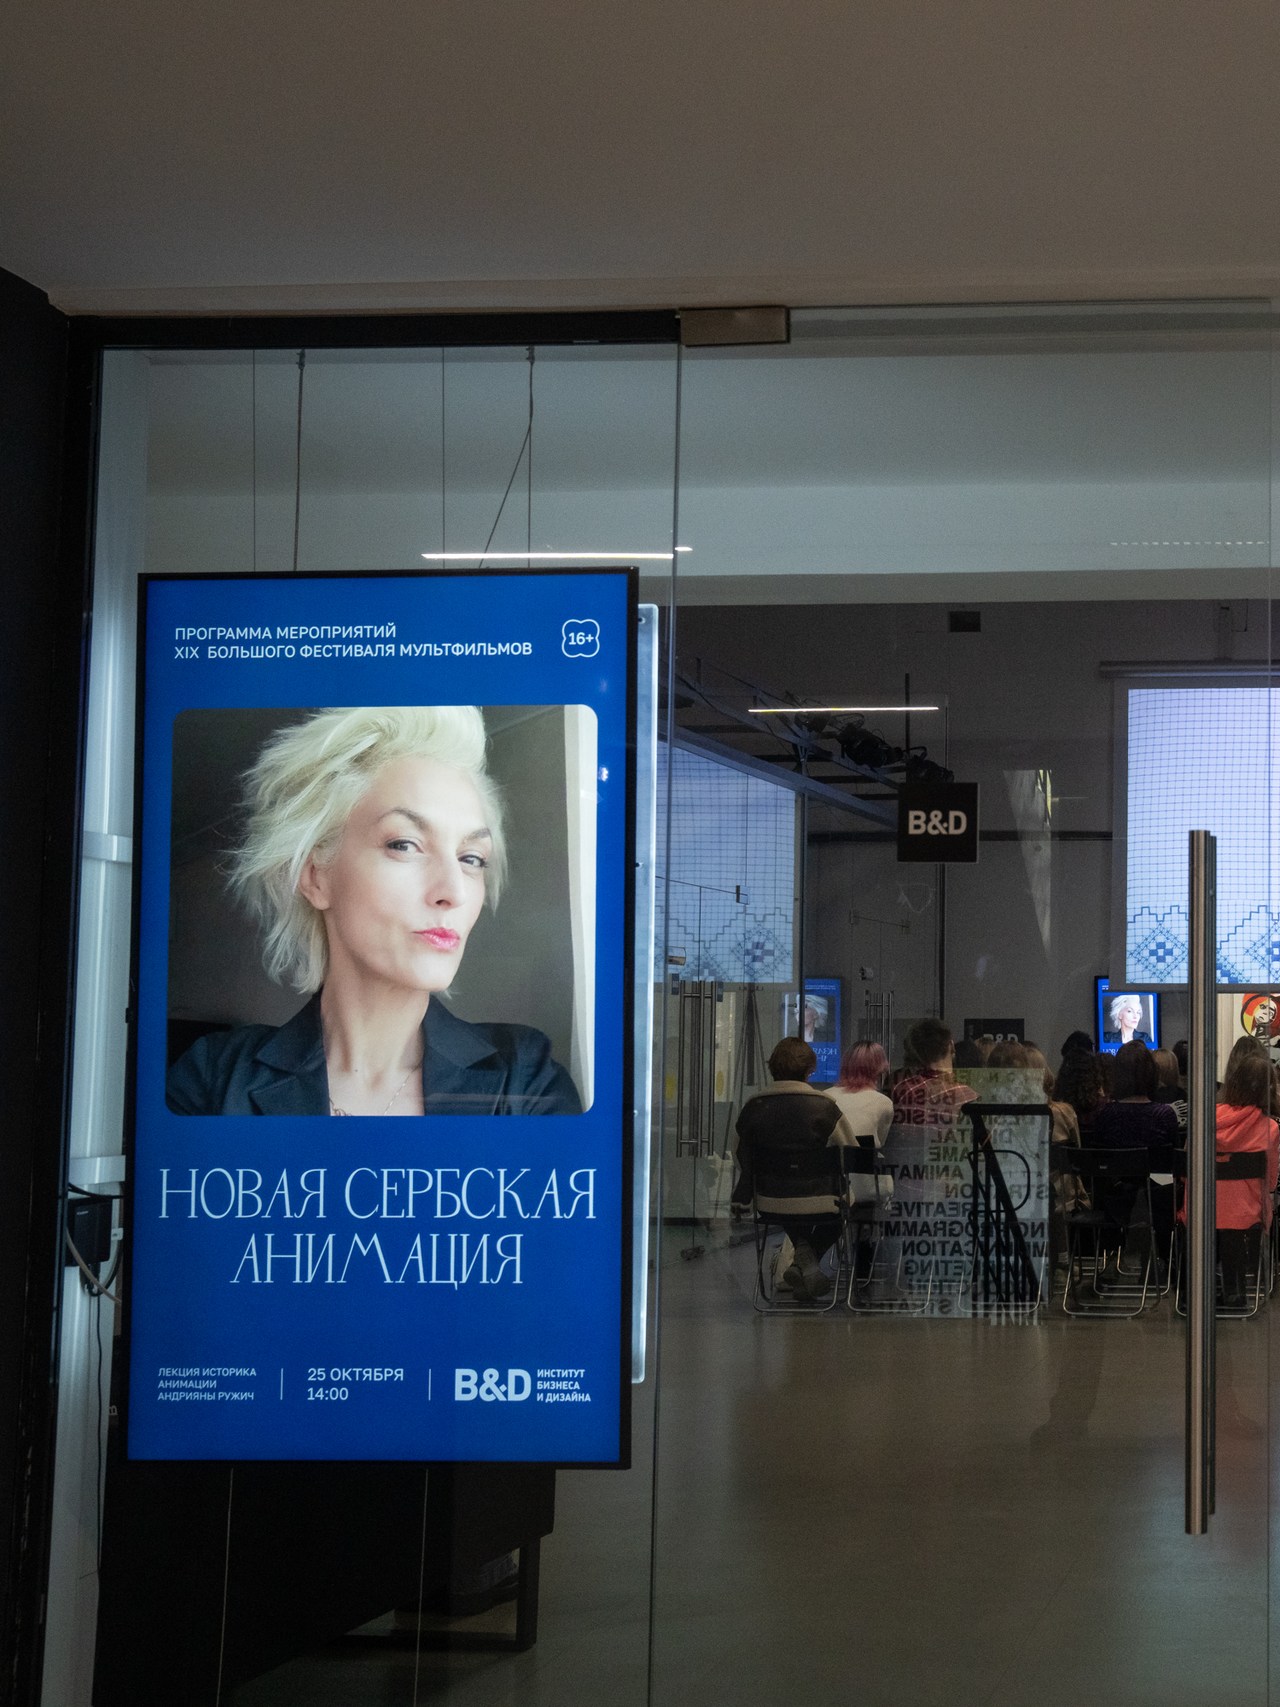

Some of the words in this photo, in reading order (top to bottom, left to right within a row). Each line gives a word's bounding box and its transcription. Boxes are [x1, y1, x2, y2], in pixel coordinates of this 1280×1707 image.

[175, 626, 273, 641] ПРОГРАММА
[276, 622, 396, 639] МЕРОПРИЯТИЙ
[568, 631, 595, 645] 16+
[174, 646, 200, 659] XIX
[207, 645, 296, 659] БОЛЬШОГО
[299, 643, 396, 658] ФЕСТИВАЛЯ
[399, 641, 533, 657] МУЛЬТФИЛЬМОВ
[908, 810, 967, 835] B&D
[159, 1167, 328, 1220] НОВАЯ
[344, 1167, 597, 1220] СЕРБСКАЯ
[229, 1232, 524, 1290] АНИМАЦИЯ
[158, 1367, 200, 1378] ЛЕКЦИЯ
[202, 1367, 257, 1377] ИСТОРИКА
[307, 1367, 326, 1381] 25
[329, 1367, 404, 1382] ОКТЯБРЯ
[536, 1368, 586, 1378] ИНСТИТУТ
[158, 1379, 217, 1390] АНИМАЦИИ
[454, 1368, 532, 1402] B&D
[536, 1380, 581, 1390] БИЗНЕСА
[157, 1391, 216, 1402] АНДРИЯНЫ
[218, 1391, 254, 1401] РУЖИЧ
[307, 1387, 349, 1401] 14:00
[536, 1392, 544, 1402] И
[545, 1391, 592, 1403] ДИЗАЙНА
